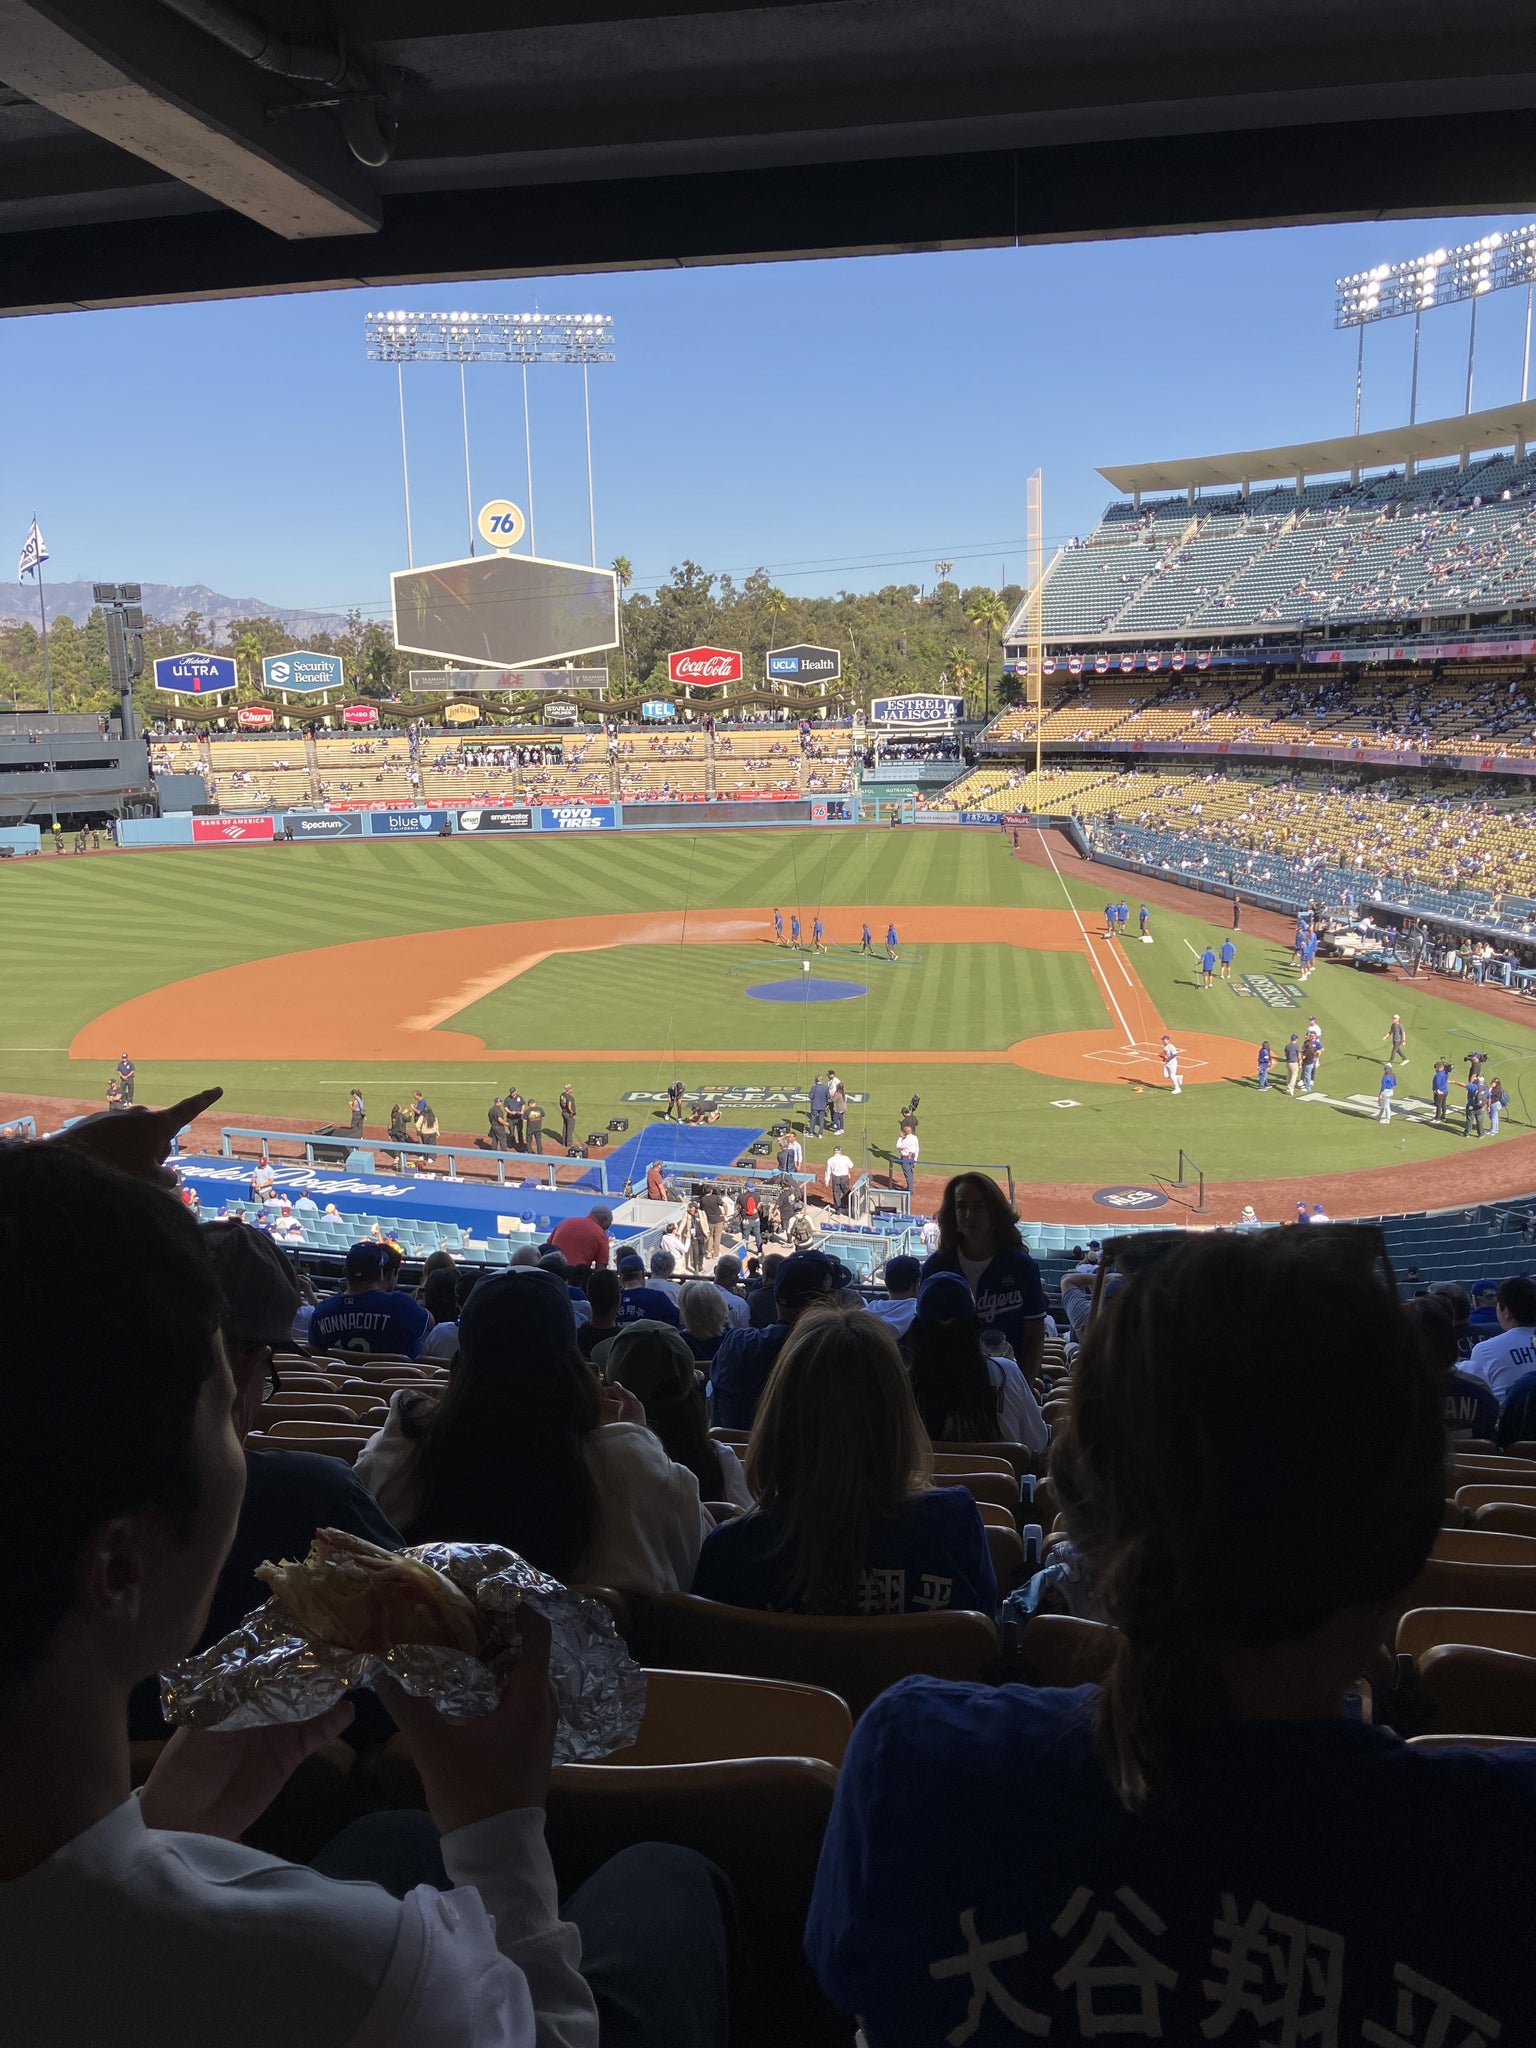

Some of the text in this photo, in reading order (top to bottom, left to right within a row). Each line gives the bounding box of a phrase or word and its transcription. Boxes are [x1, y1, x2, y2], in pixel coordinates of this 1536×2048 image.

[490, 513, 514, 533] 76
[179, 656, 211, 666] Michelob
[773, 659, 834, 670] UCLA Health
[173, 666, 219, 676] ULTRA
[294, 661, 335, 673] Security
[676, 656, 735, 677] Coca-Cola
[295, 672, 333, 682] Benefit
[646, 704, 670, 715] TEL
[881, 710, 940, 719] JALISCO
[240, 712, 272, 722] Churu
[551, 809, 592, 819] TOYO
[814, 807, 825, 816] 76
[389, 816, 418, 827] blue
[491, 813, 529, 821] smartwater
[1005, 816, 1030, 824] Yakult
[302, 820, 342, 829] Spectrum
[558, 818, 601, 828] TIRES
[627, 1093, 863, 1102] POSTSEASN
[977, 1288, 1023, 1323] dgers
[616, 1304, 647, 1318] 谷翔平
[317, 1312, 391, 1335] WONNACOTT
[1509, 1346, 1536, 1365] OH
[1445, 1395, 1478, 1422] ANI
[857, 1568, 953, 1616] 翔平
